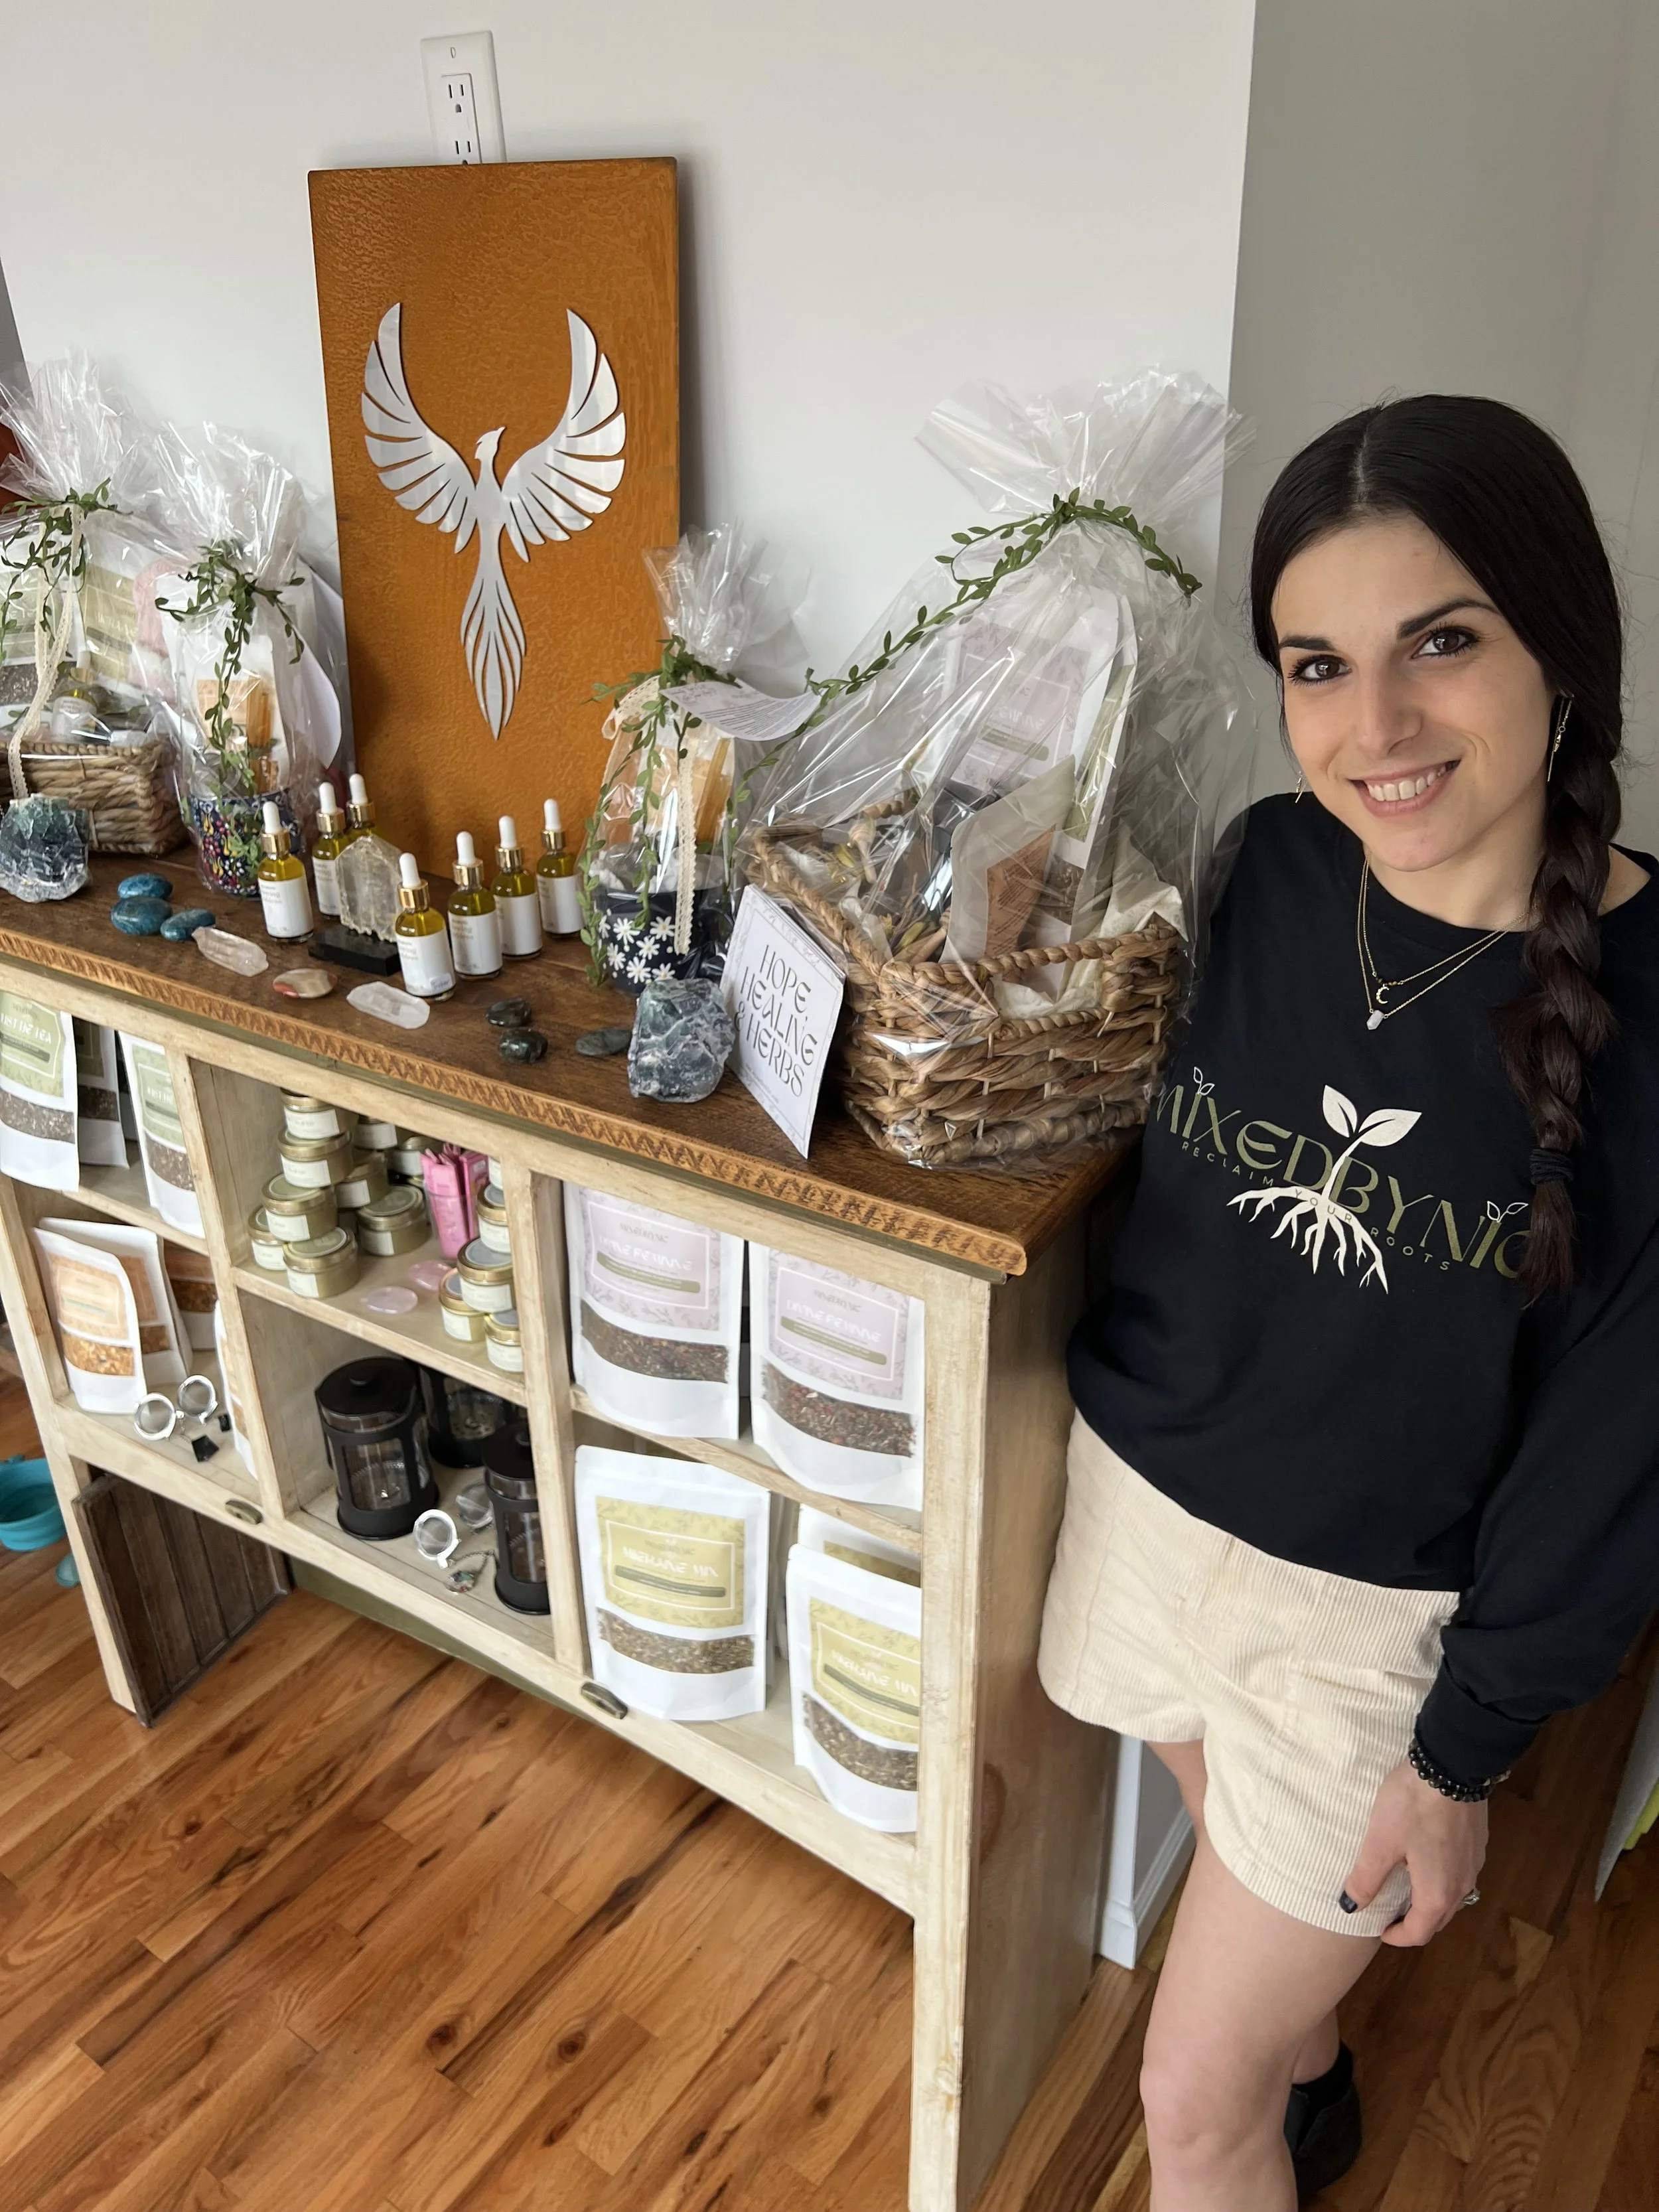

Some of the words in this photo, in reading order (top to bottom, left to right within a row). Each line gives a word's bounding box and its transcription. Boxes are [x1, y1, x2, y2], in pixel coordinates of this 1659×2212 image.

[734, 1001, 745, 1033] &
[746, 1012, 804, 1098] HERBS
[740, 966, 818, 1067] HEALING
[1181, 1141, 1274, 1187] RECLAIM
[1294, 1189, 1352, 1222] YOUR
[1370, 1226, 1451, 1271] ROOTS
